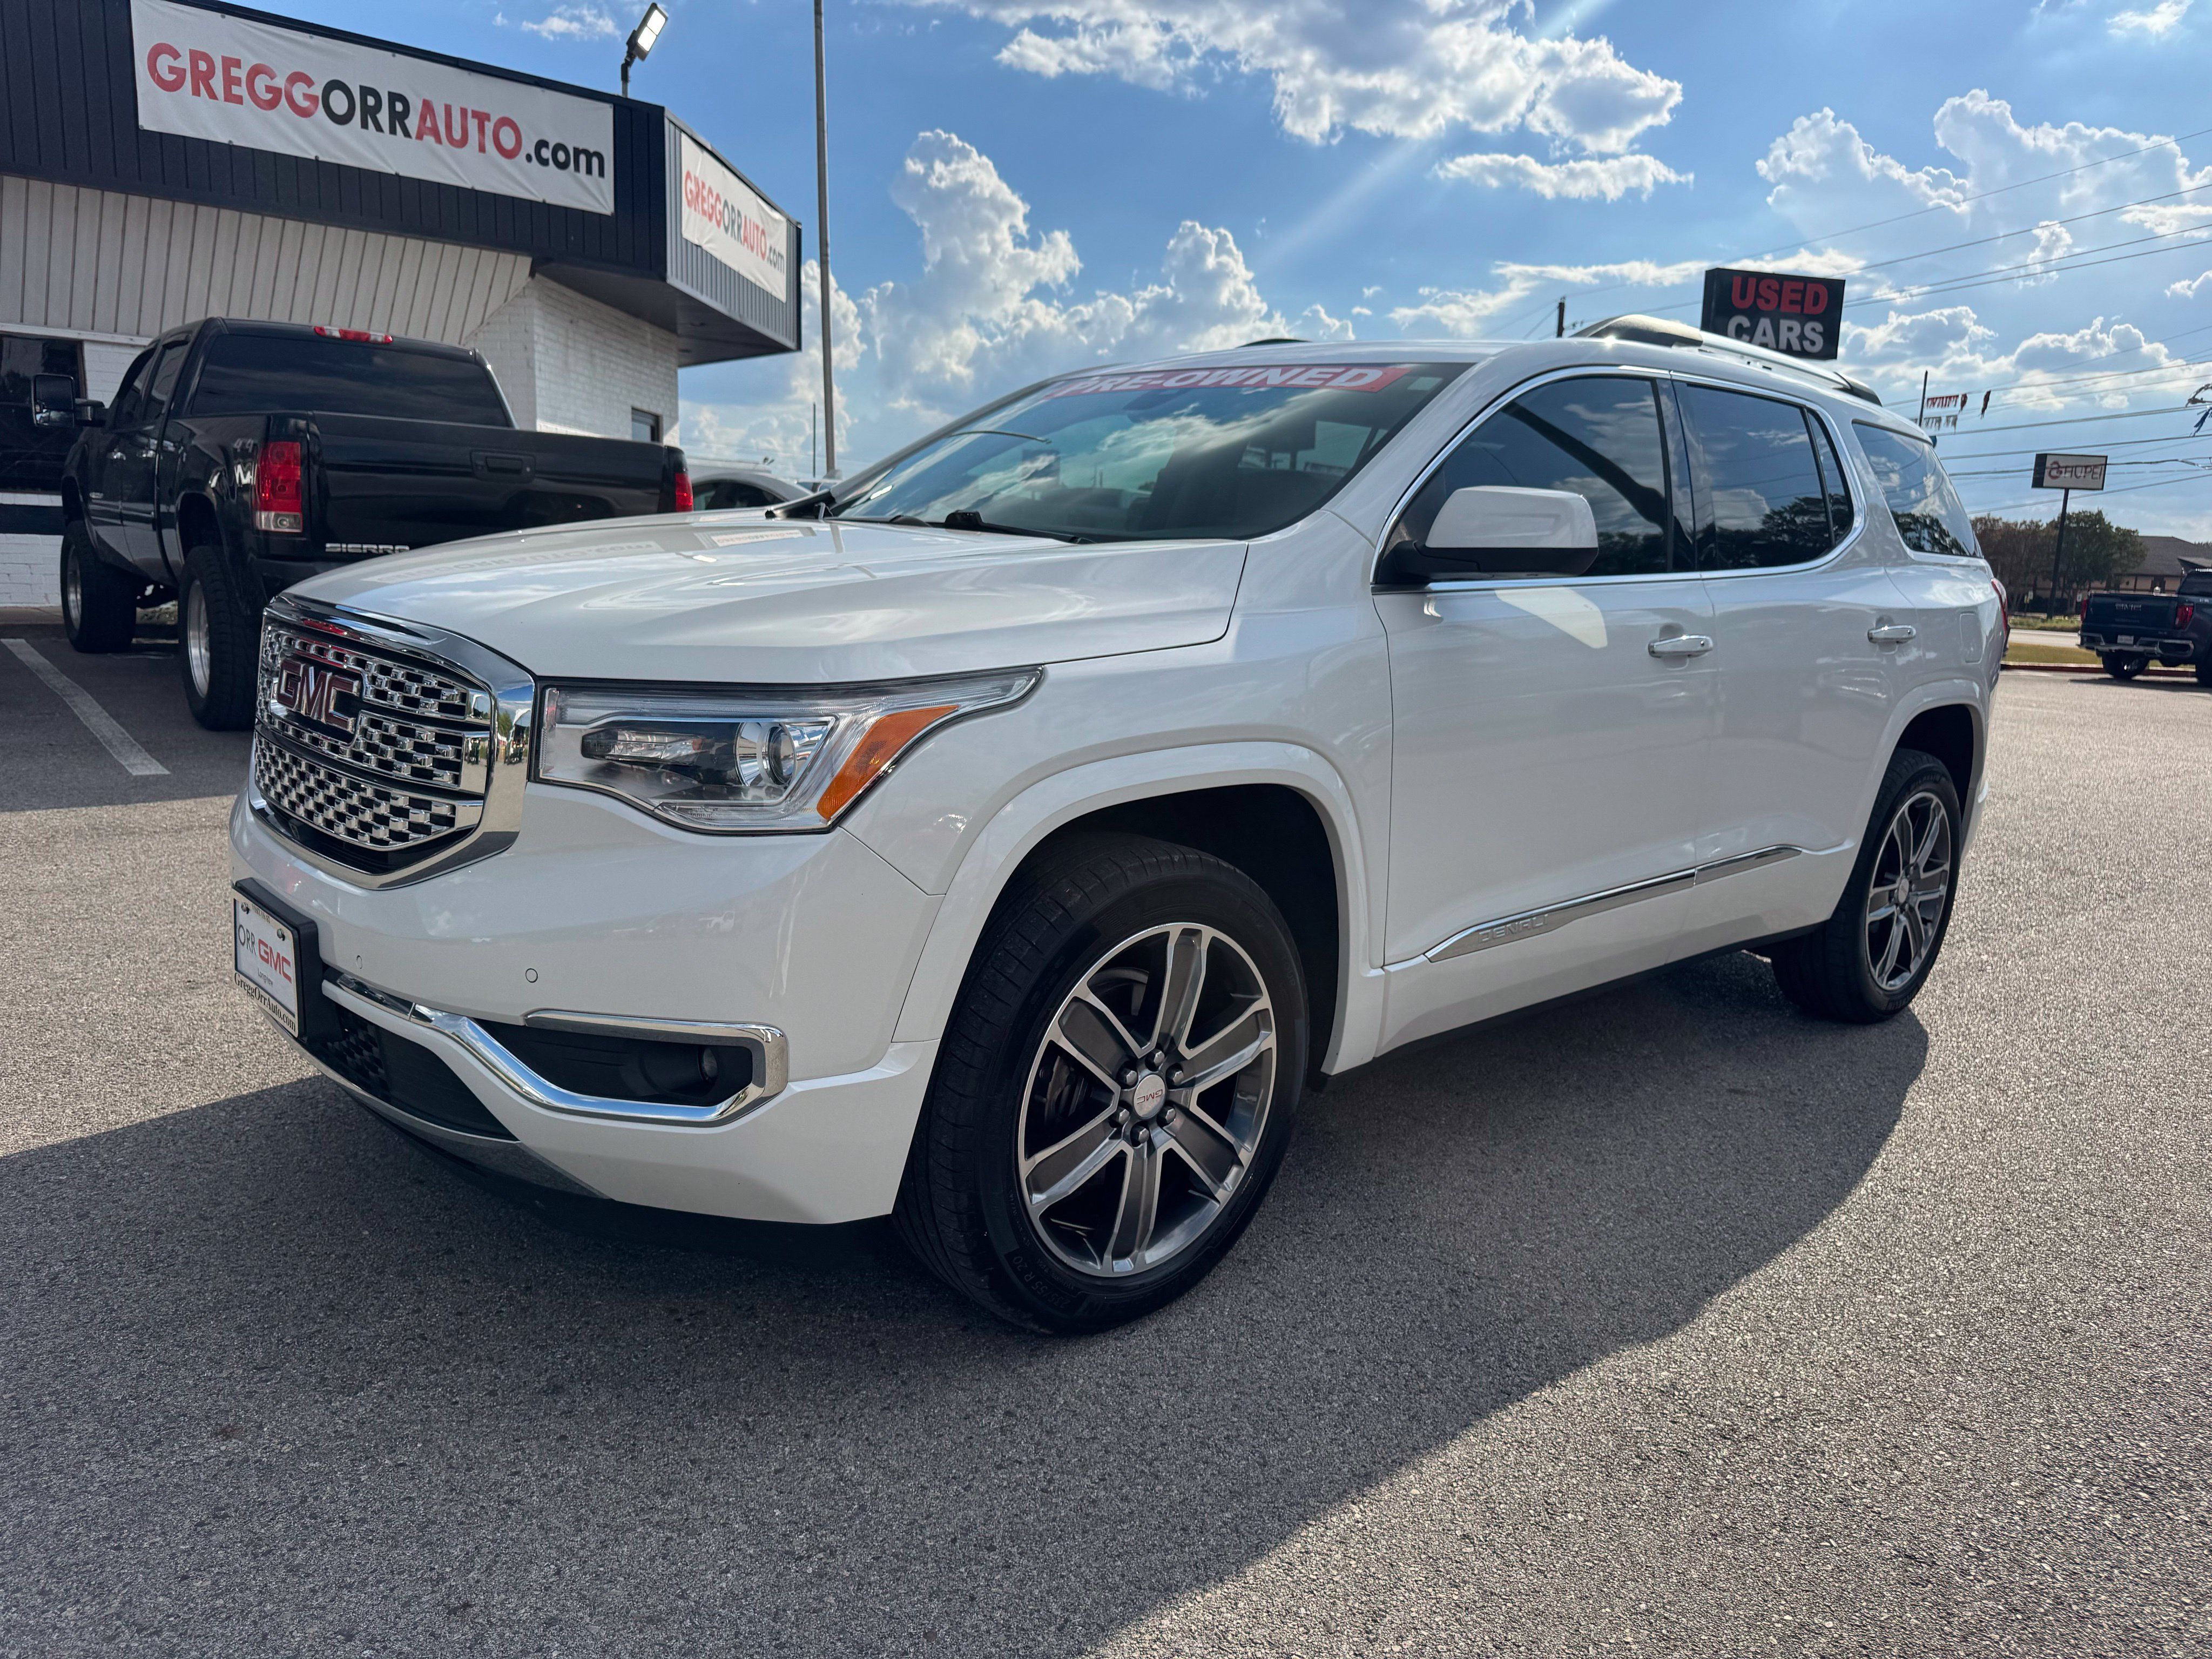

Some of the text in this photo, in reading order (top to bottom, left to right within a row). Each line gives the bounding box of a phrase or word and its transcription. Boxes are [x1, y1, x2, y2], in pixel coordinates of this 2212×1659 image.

[147, 42, 605, 178] GREGGORRAUTO.com
[685, 171, 785, 274] GREGGORRAUTO.com
[1731, 275, 1829, 315] USED
[1727, 315, 1824, 353] CARS
[1053, 368, 1383, 397] PRE-OWNED
[276, 658, 362, 733] GMC
[238, 925, 292, 984] ORR GMC
[234, 972, 296, 1033] GreggOrrAuto.com
[1137, 1089, 1163, 1105] GMC
